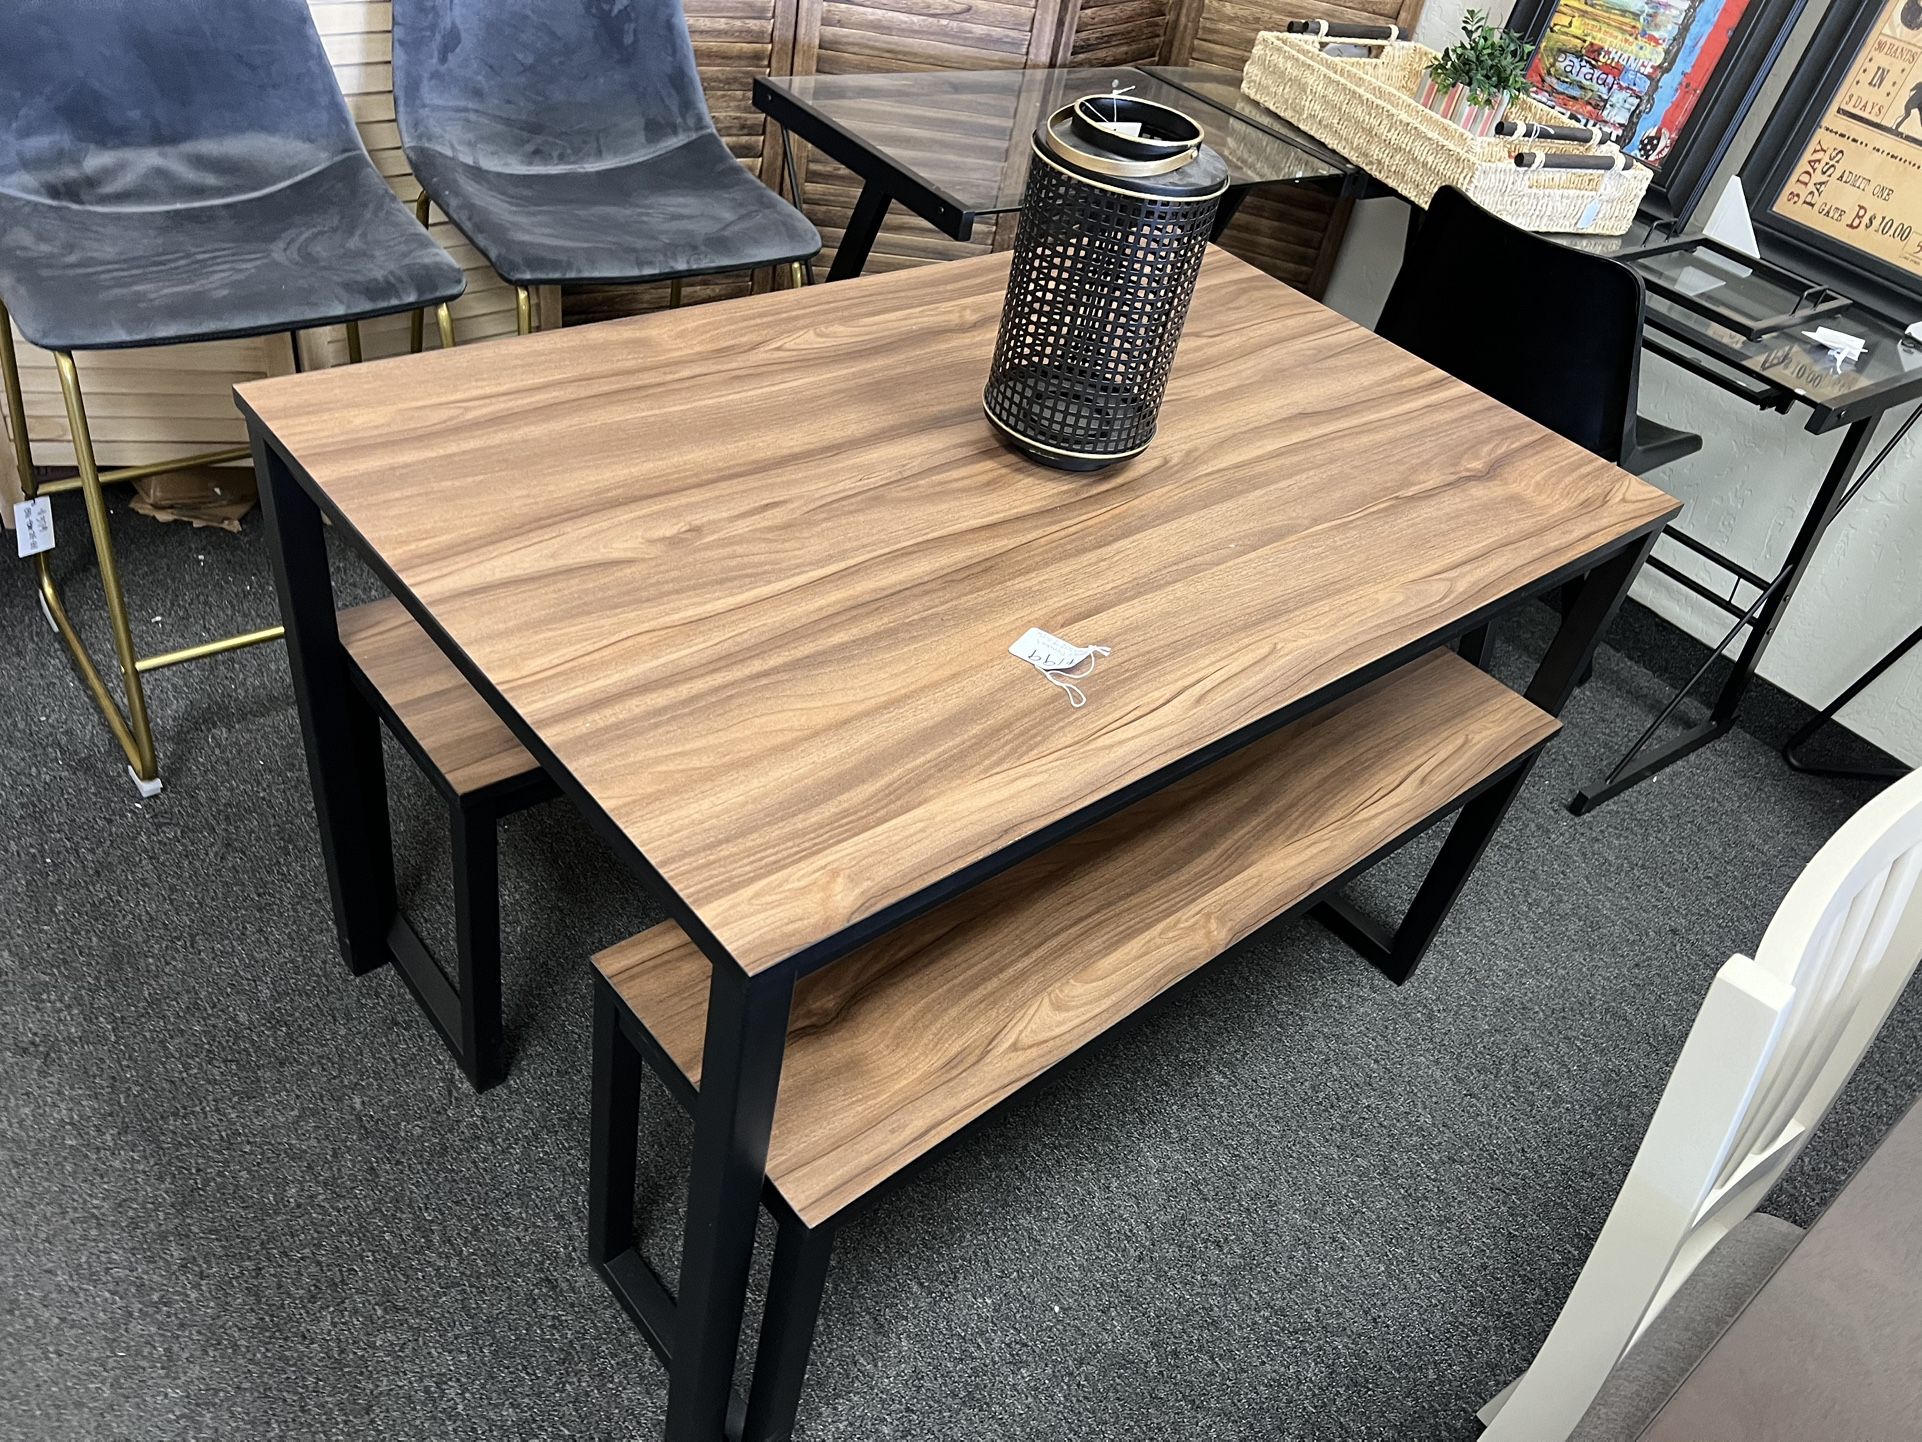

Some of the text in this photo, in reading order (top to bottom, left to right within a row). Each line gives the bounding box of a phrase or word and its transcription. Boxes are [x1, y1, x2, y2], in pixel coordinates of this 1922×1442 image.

[1867, 65, 1889, 90] IN
[1853, 96, 1886, 118] DAYS
[1786, 139, 1829, 206] 3 DAY
[1801, 147, 1845, 210] PASS
[1836, 169, 1895, 202] ADMIT ONE
[1817, 202, 1847, 223] GATE
[1846, 204, 1868, 230] B
